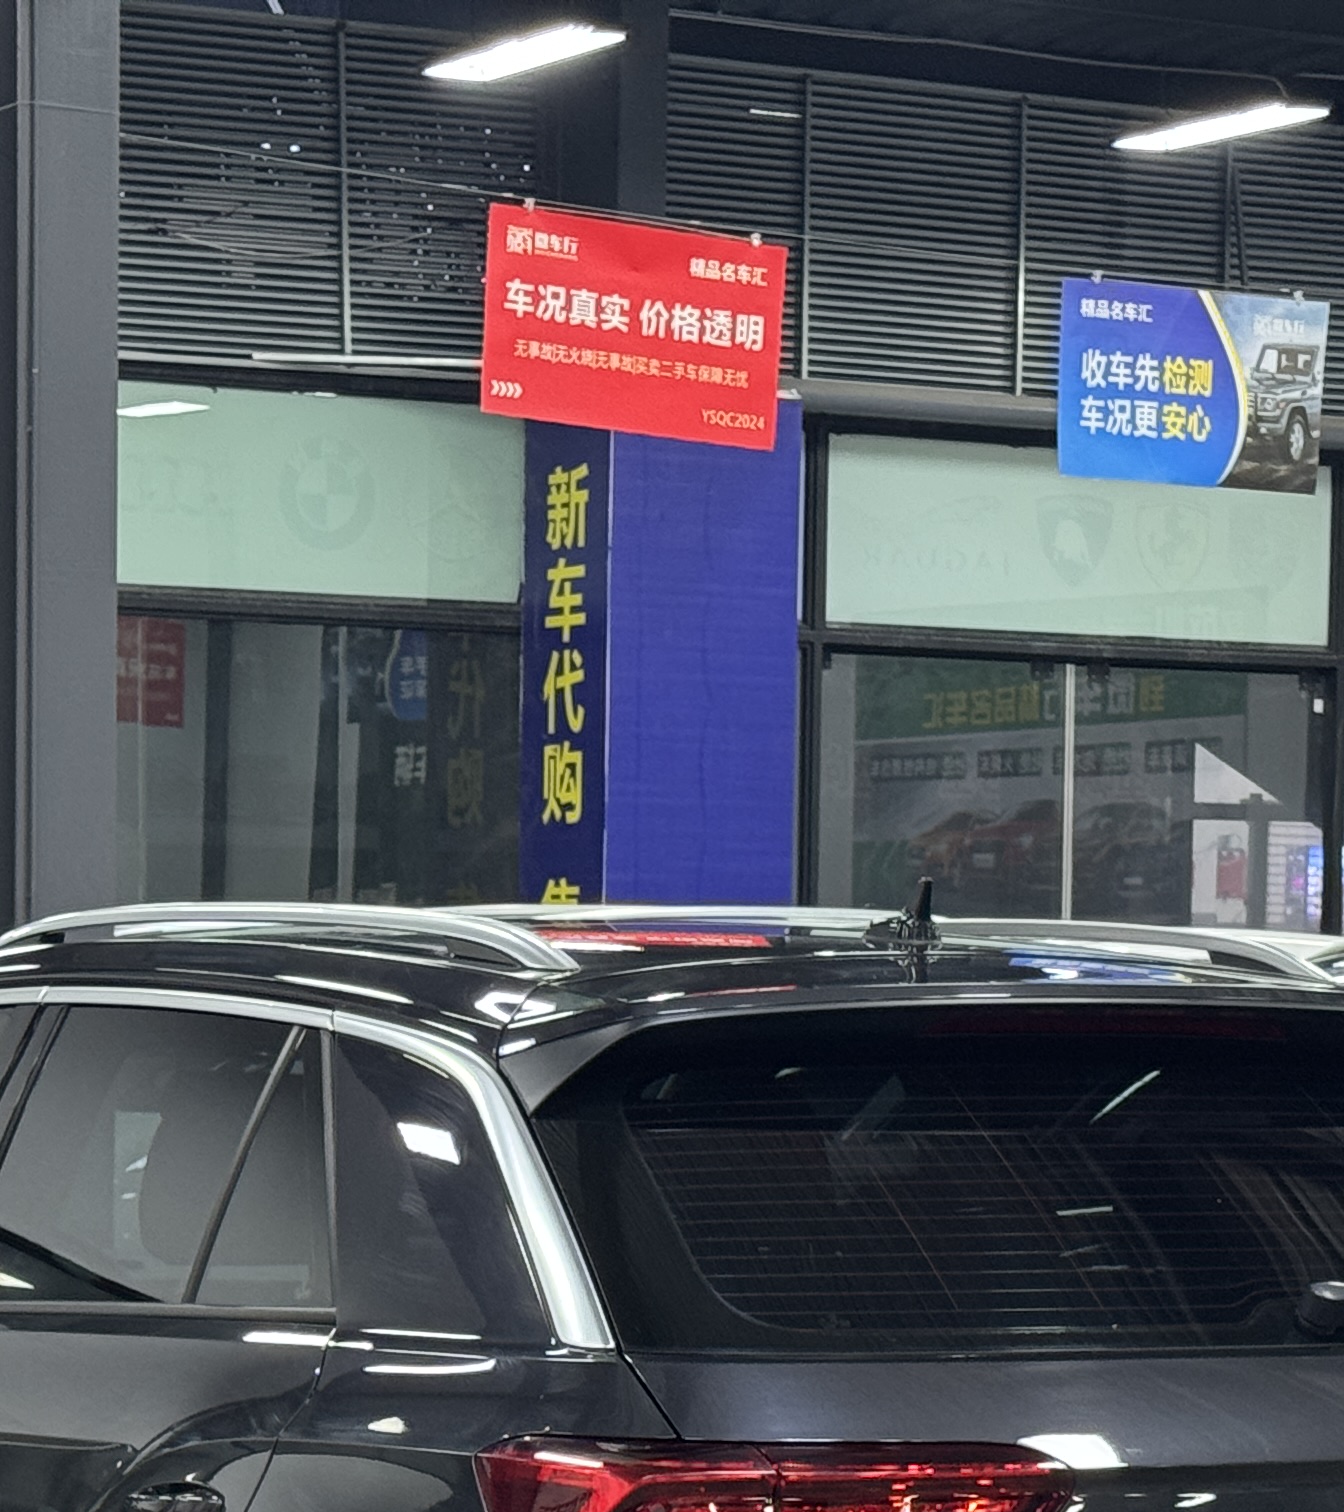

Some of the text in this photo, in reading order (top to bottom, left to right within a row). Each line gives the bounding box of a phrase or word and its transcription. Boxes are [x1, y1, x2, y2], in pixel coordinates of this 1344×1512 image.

[689, 257, 768, 287] 精品名车汇
[504, 278, 765, 351] 车况真实 价格透明
[1080, 298, 1154, 322] 精品名车汇
[1081, 348, 1214, 397] 收车先检测
[701, 408, 765, 430] YSQC2024
[1079, 395, 1212, 443] 车况更安心
[541, 463, 590, 825] 新车代购
